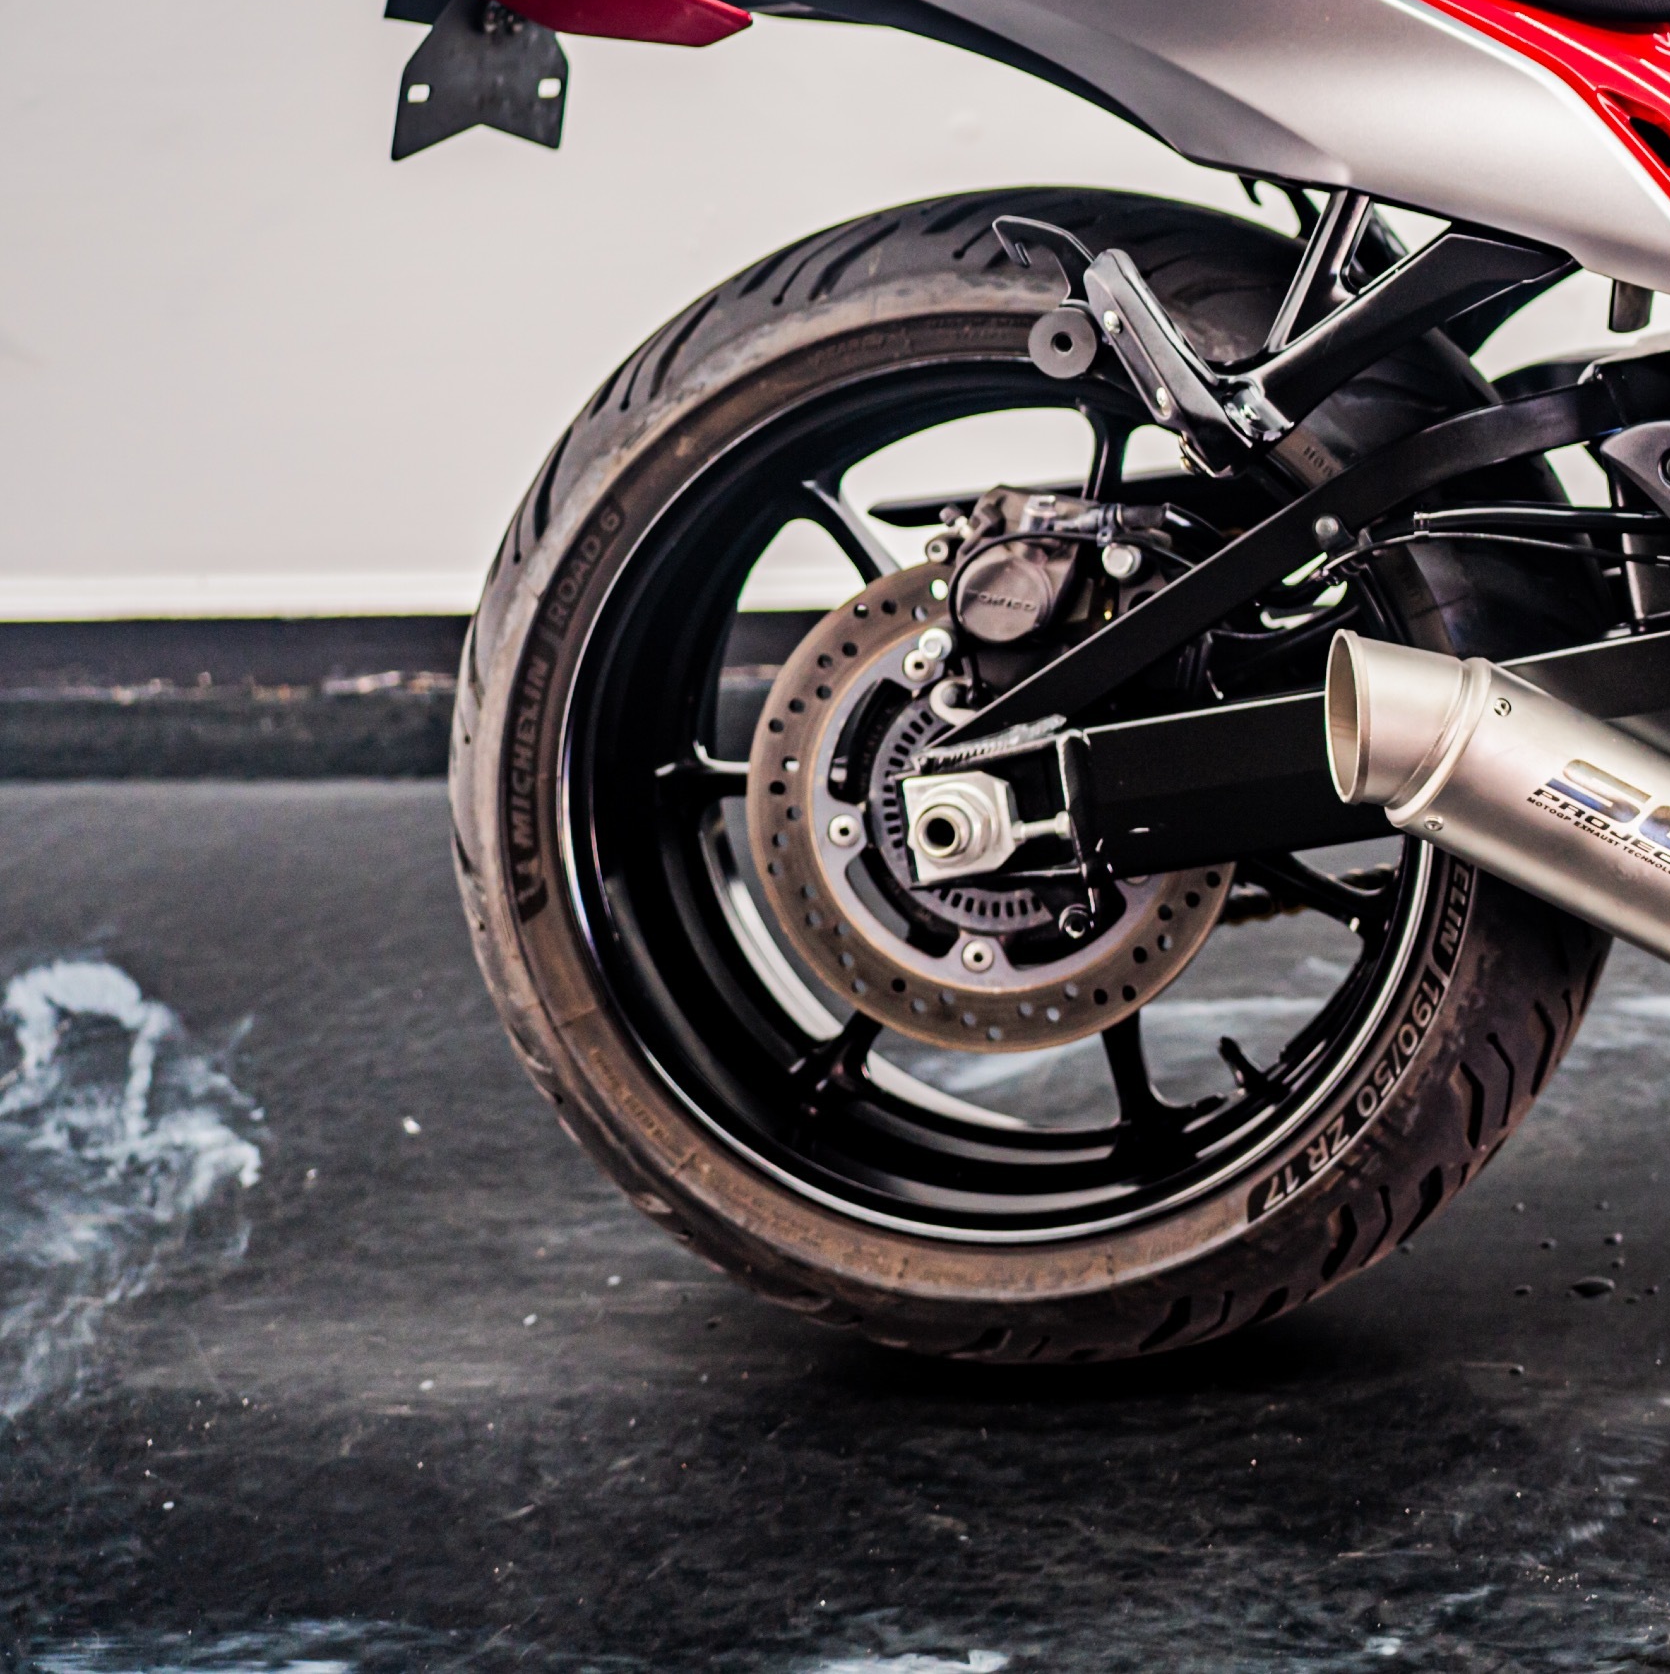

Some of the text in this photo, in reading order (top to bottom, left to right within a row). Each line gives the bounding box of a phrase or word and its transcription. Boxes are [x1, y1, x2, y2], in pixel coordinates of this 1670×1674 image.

[511, 653, 548, 849] MICHELIN
[547, 534, 601, 624] ROAD
[1526, 796, 1572, 821] MOTOGP
[1573, 820, 1620, 847] EXHAUST
[1263, 862, 1471, 1211] ELIN 190/50 ZR 17
